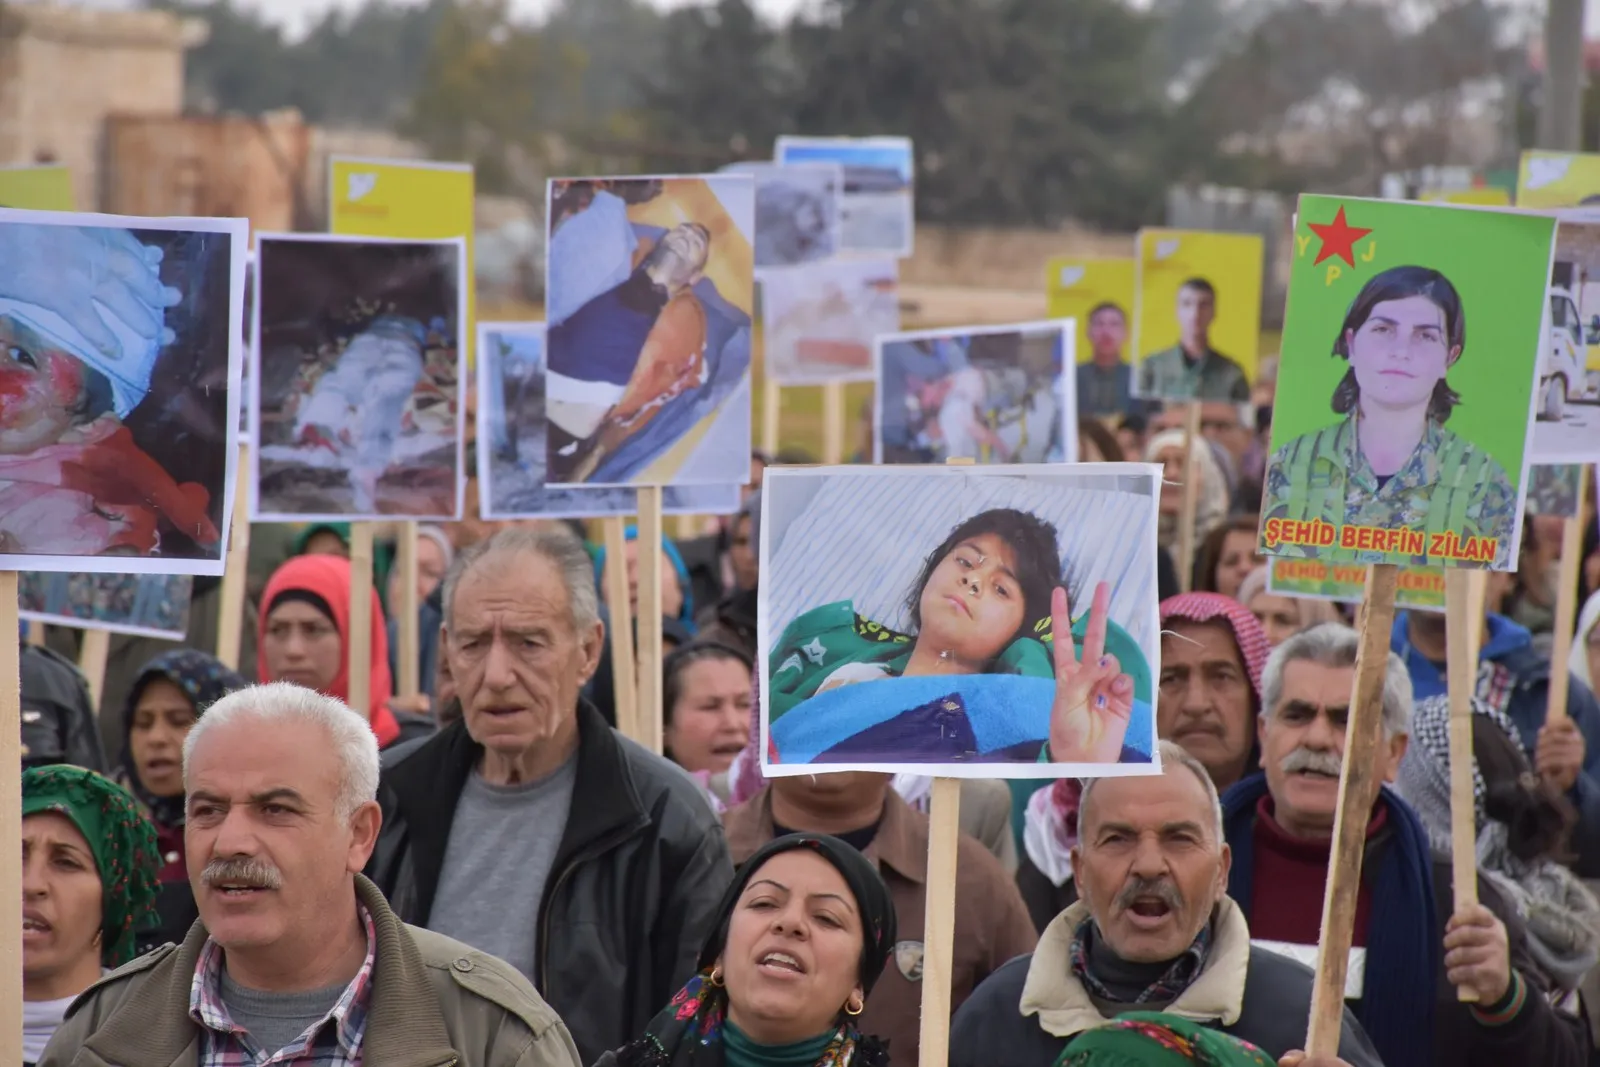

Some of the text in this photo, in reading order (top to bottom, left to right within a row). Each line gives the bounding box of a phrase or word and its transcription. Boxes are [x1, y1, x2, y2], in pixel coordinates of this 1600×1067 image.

[1297, 235, 1376, 286] Y P J
[1265, 517, 1497, 561] ŞEHÎD BERFÎN ZÎLAN
